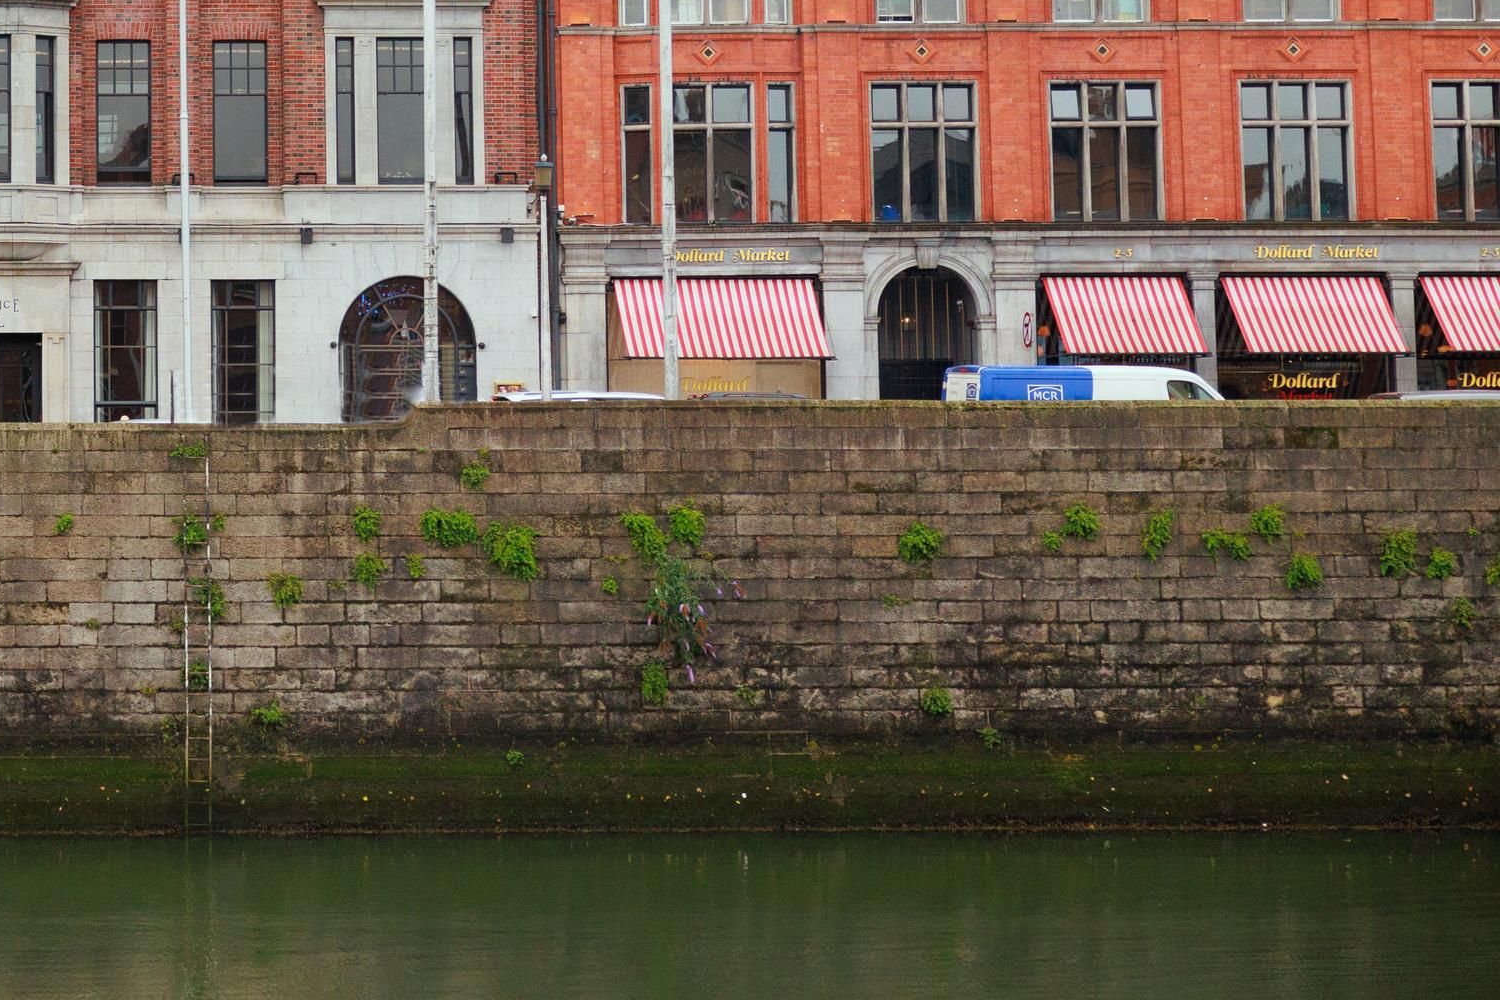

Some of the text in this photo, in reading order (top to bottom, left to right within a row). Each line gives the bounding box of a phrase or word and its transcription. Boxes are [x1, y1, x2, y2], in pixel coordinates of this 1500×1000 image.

[731, 247, 790, 262] Market
[1114, 248, 1133, 259] 2-5
[1253, 244, 1379, 259] Dollard Market
[1267, 372, 1341, 389] Dollard
[1033, 390, 1059, 400] MCR
